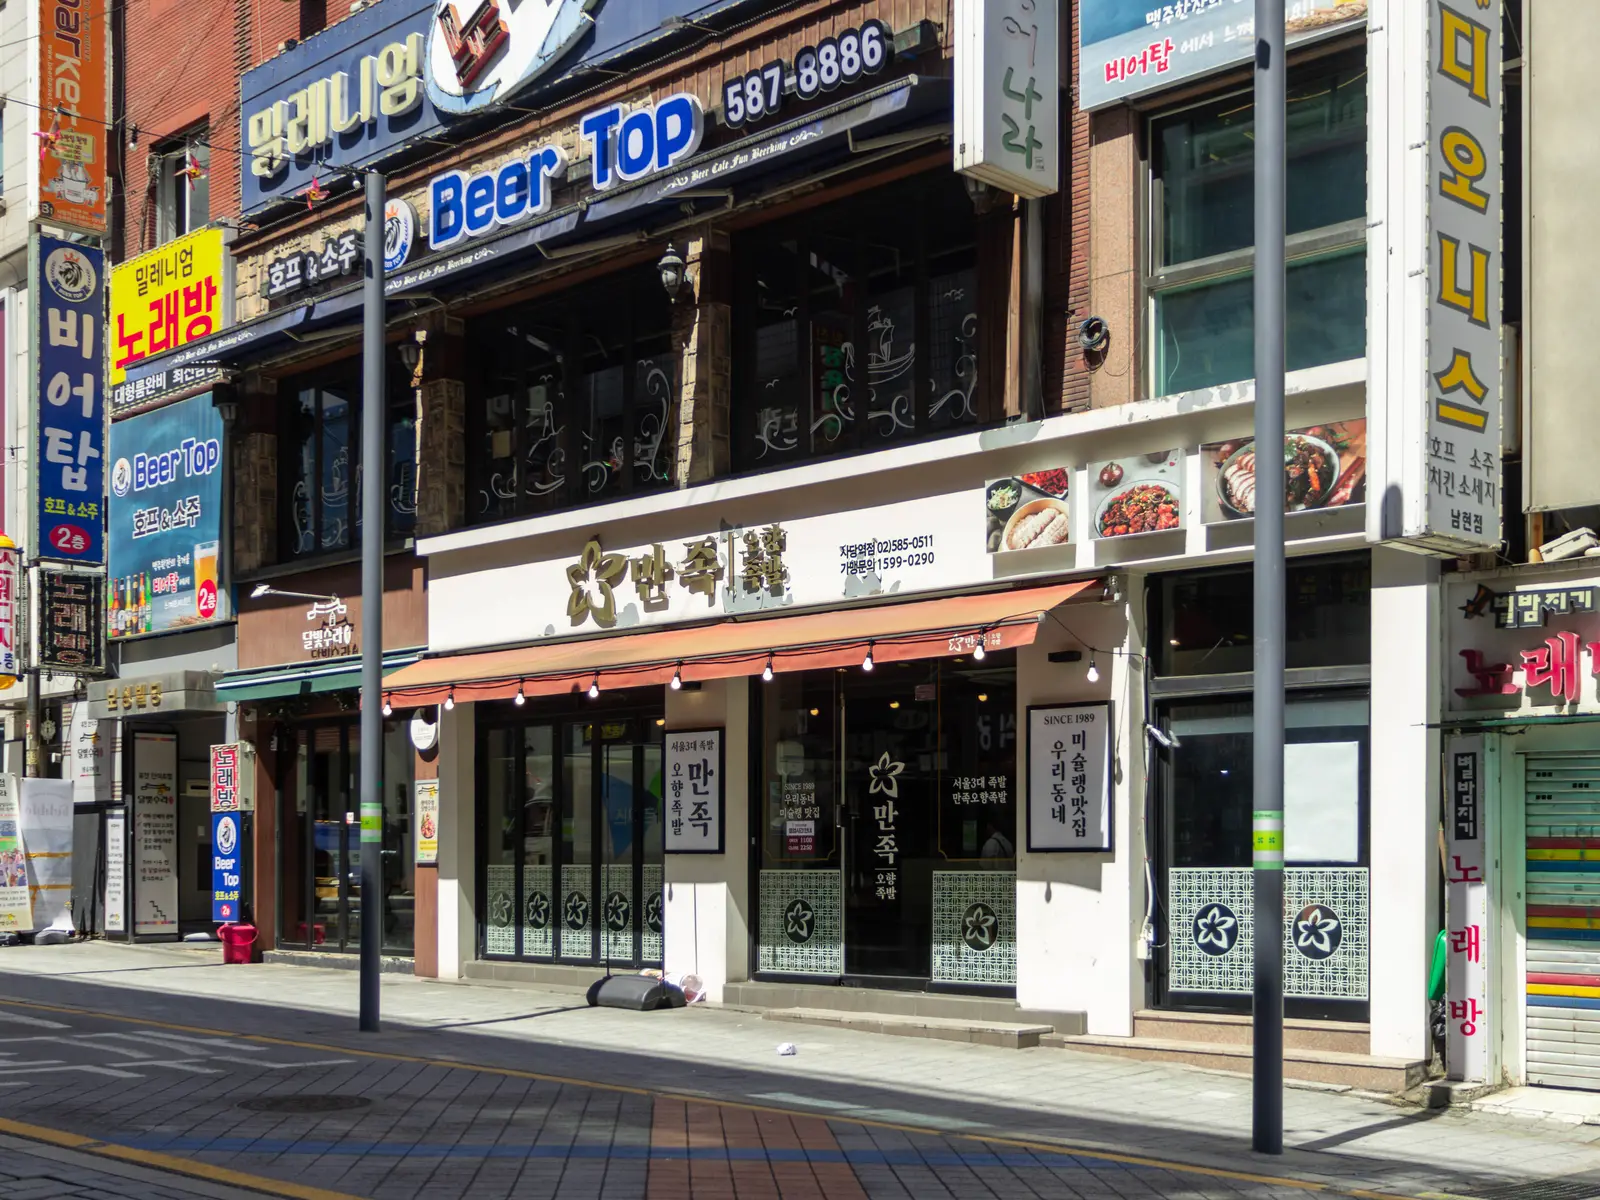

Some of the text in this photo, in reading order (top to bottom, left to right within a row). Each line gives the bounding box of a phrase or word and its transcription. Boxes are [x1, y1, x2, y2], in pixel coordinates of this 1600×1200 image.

[54, 0, 81, 127] arket
[726, 25, 884, 123] 587-8886
[1104, 36, 1175, 84] 비어탑
[1180, 32, 1214, 54] 에서
[248, 31, 425, 178] 밀레니엄
[430, 146, 563, 248] Beer
[135, 245, 193, 296] 밀레니엄
[116, 275, 217, 369] 노래방
[44, 307, 100, 491] 비어탑
[114, 373, 167, 404] 대형룸완비
[134, 451, 181, 491] Beer
[1430, 436, 1495, 478] 호프 소주
[1429, 465, 1496, 508] 치킨 소세지
[57, 526, 86, 550] 2층
[1450, 508, 1483, 535] 남현점
[840, 551, 935, 575] 가맹문의 1599-0290
[877, 534, 933, 554] 02)585-0511
[153, 571, 179, 593] 비어탑
[628, 535, 723, 604] 만족
[53, 575, 91, 663] 노래방
[199, 587, 217, 610] 2층
[1493, 588, 1593, 625] 별밤지기
[1043, 713, 1095, 726] SINCE 1989
[671, 738, 715, 753] 서울3대 족발
[216, 750, 234, 808] 노래방
[670, 762, 684, 836] 오향족발
[687, 758, 715, 838] 만족
[784, 792, 815, 806] 우리동네
[952, 775, 1007, 790] 서울3대 족발
[952, 790, 1007, 805] 만족오향족발
[1050, 739, 1067, 825] 우리동네
[1070, 729, 1088, 838] 미슐랭맛집
[1457, 755, 1475, 837] 별밤지기
[873, 800, 899, 864] 만족
[214, 856, 236, 871] Beer
[874, 872, 897, 886] 오향
[874, 886, 897, 900] 족발
[1448, 855, 1483, 1037] 노래방
